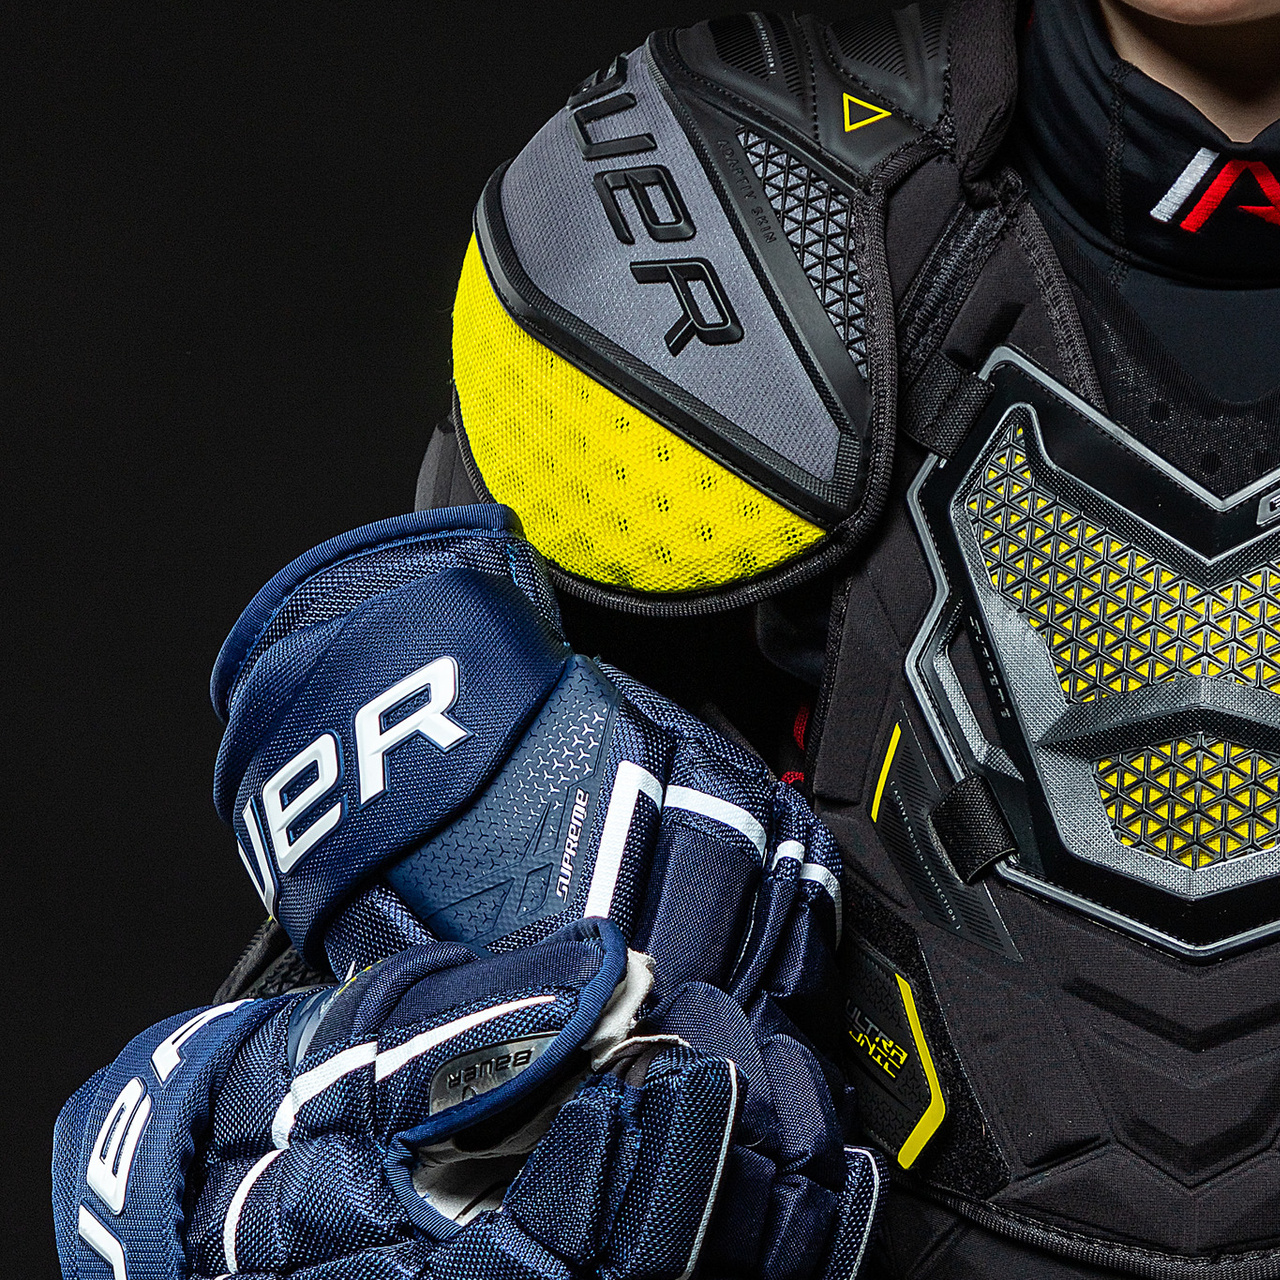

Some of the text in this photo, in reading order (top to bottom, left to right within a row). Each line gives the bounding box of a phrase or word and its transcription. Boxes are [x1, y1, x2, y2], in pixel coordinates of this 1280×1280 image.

[567, 54, 744, 357] UER
[751, 206, 777, 244] SKIN
[237, 655, 475, 924] UER
[556, 788, 590, 904] SUPREME
[924, 865, 957, 922] PROTECTION
[446, 1047, 535, 1089] BAUER
